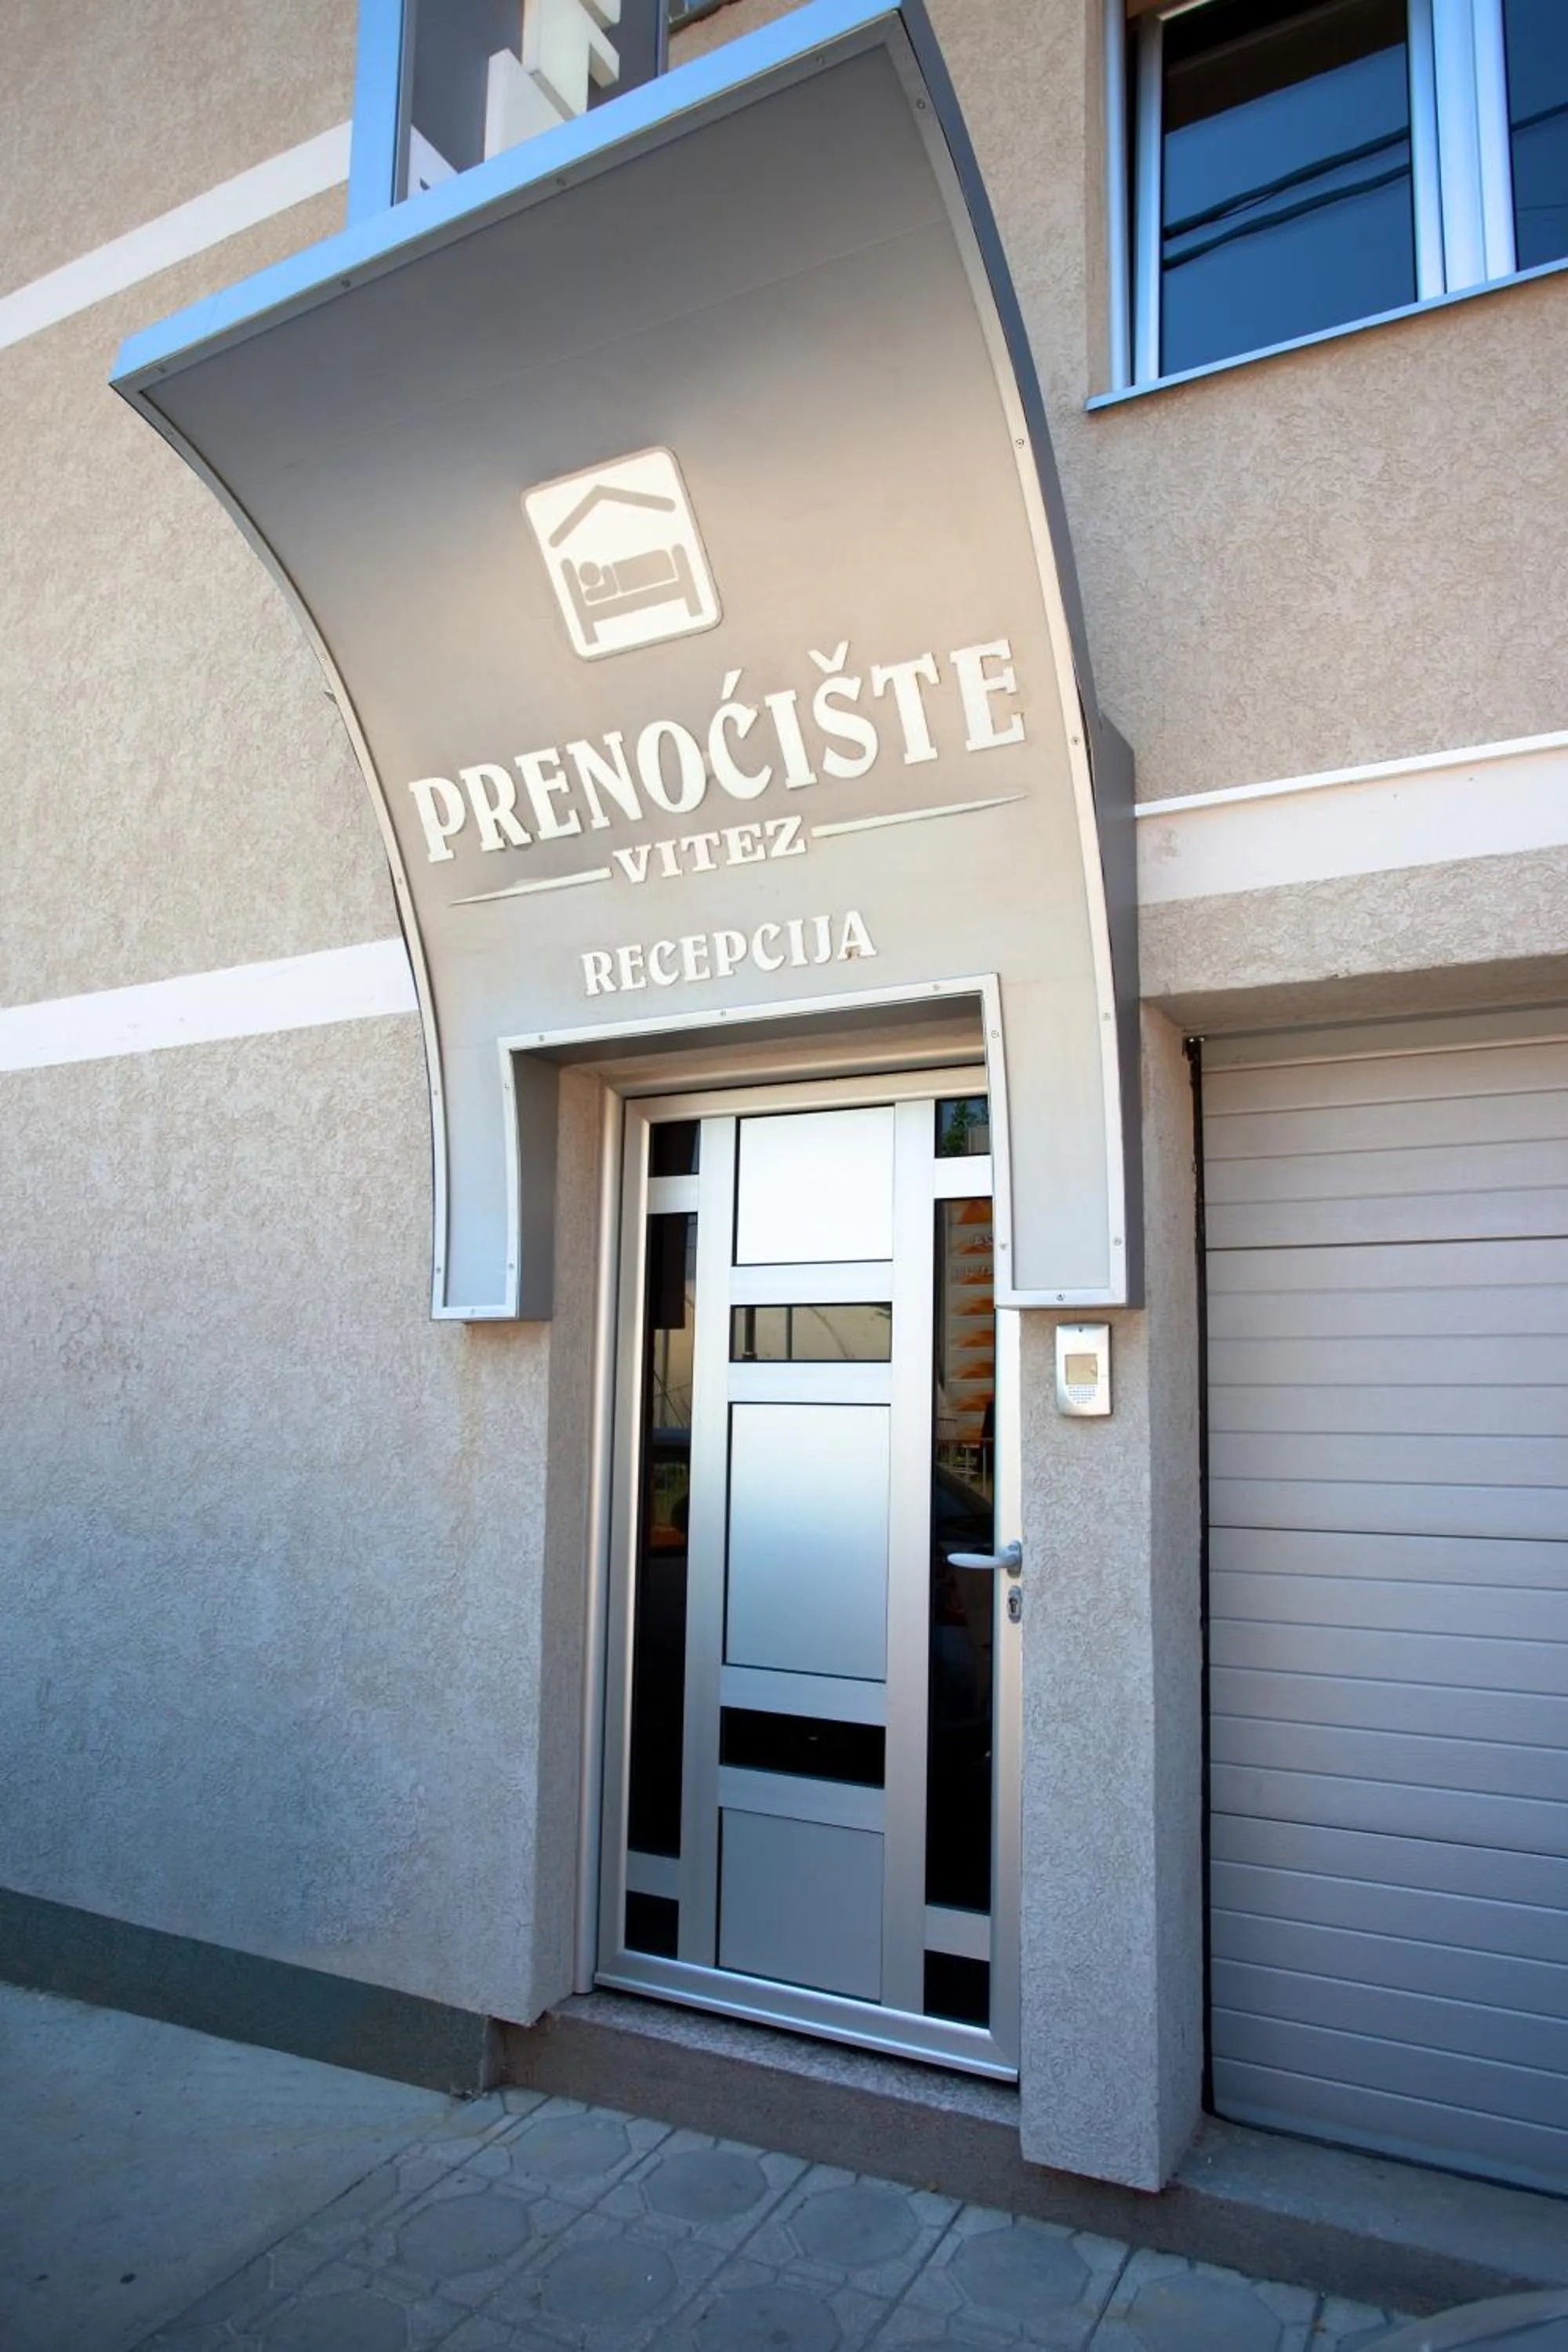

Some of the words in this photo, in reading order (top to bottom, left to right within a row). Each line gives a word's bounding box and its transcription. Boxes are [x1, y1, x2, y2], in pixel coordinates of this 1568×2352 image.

[408, 639, 1025, 863] PRENOĆIŠTE
[614, 815, 807, 884] VITEZ
[581, 911, 877, 996] RECEPCIJA
